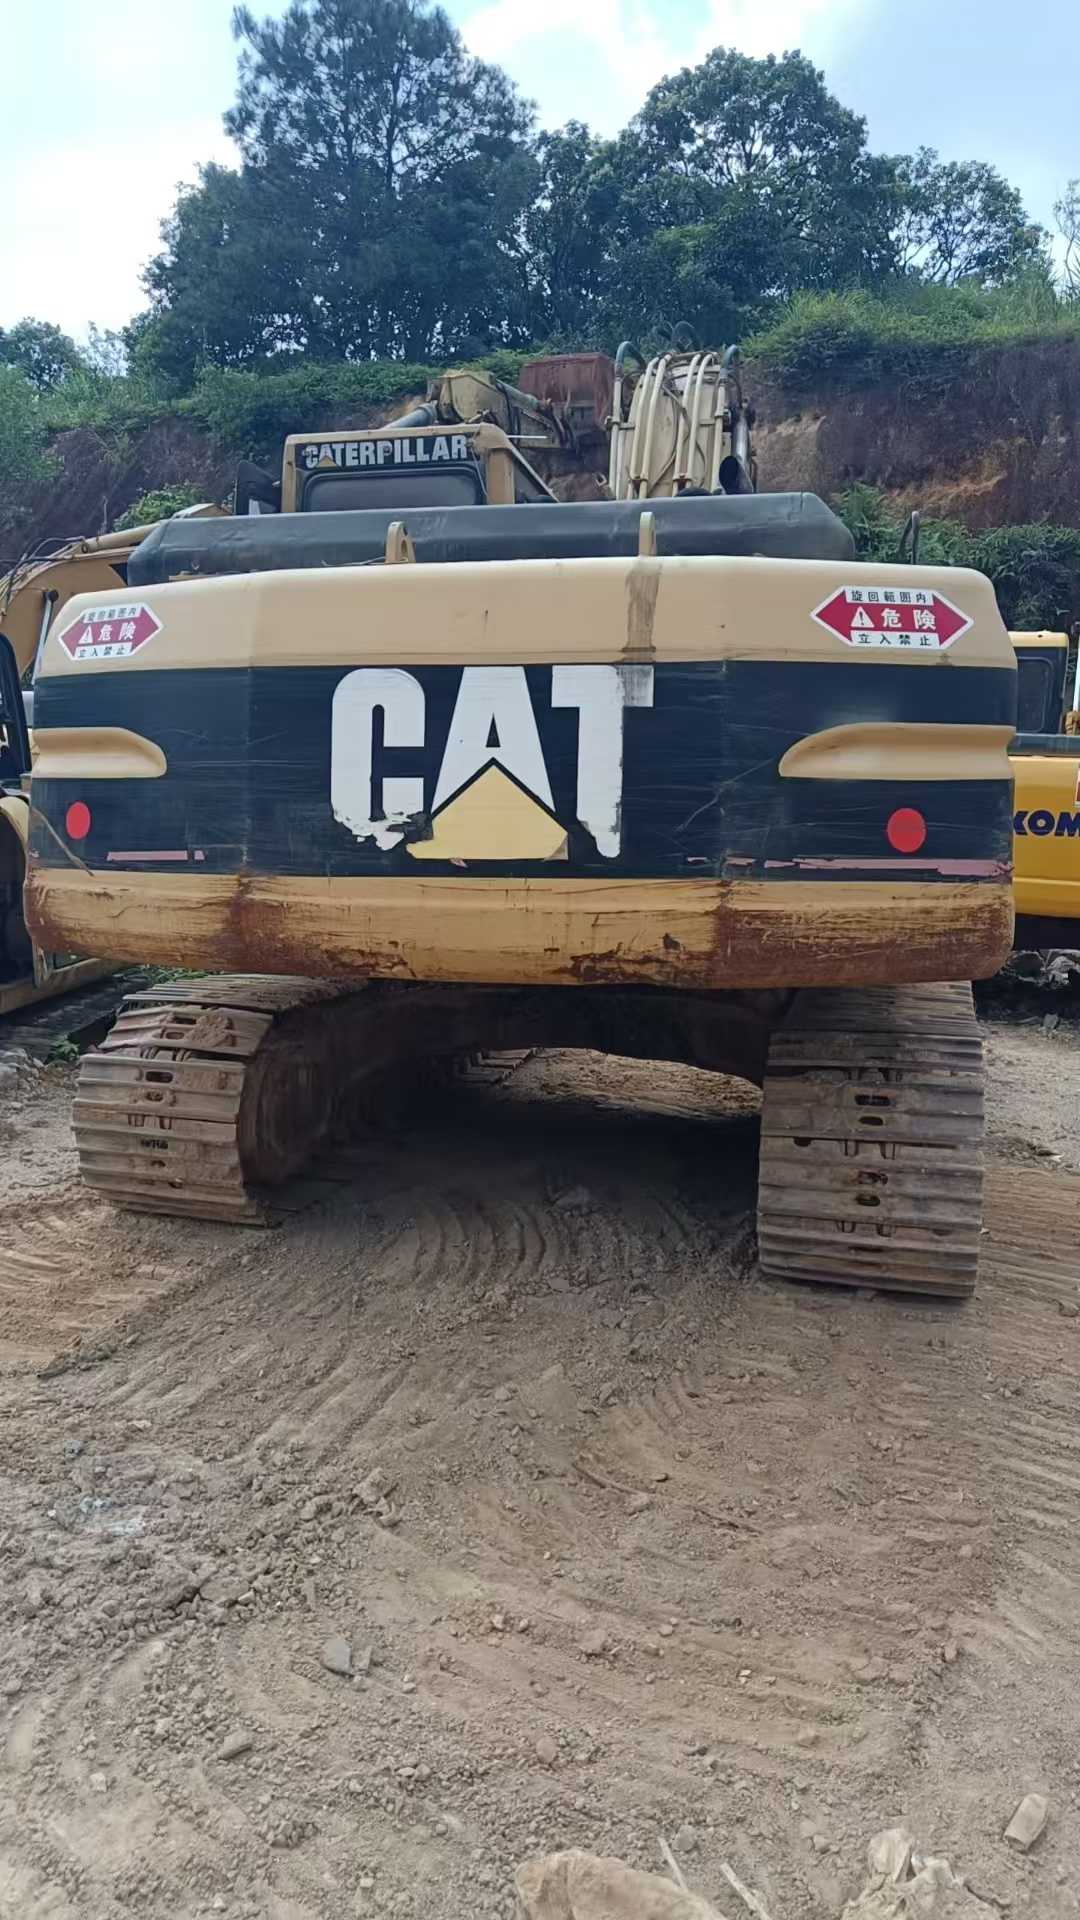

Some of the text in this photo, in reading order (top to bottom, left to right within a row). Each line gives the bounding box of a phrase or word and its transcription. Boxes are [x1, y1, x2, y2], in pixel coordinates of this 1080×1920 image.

[304, 434, 468, 469] CATERPILLAR
[881, 607, 937, 630] 危険
[98, 621, 137, 641] 危険
[858, 633, 932, 646] 立入禁止
[331, 665, 654, 858] CAT
